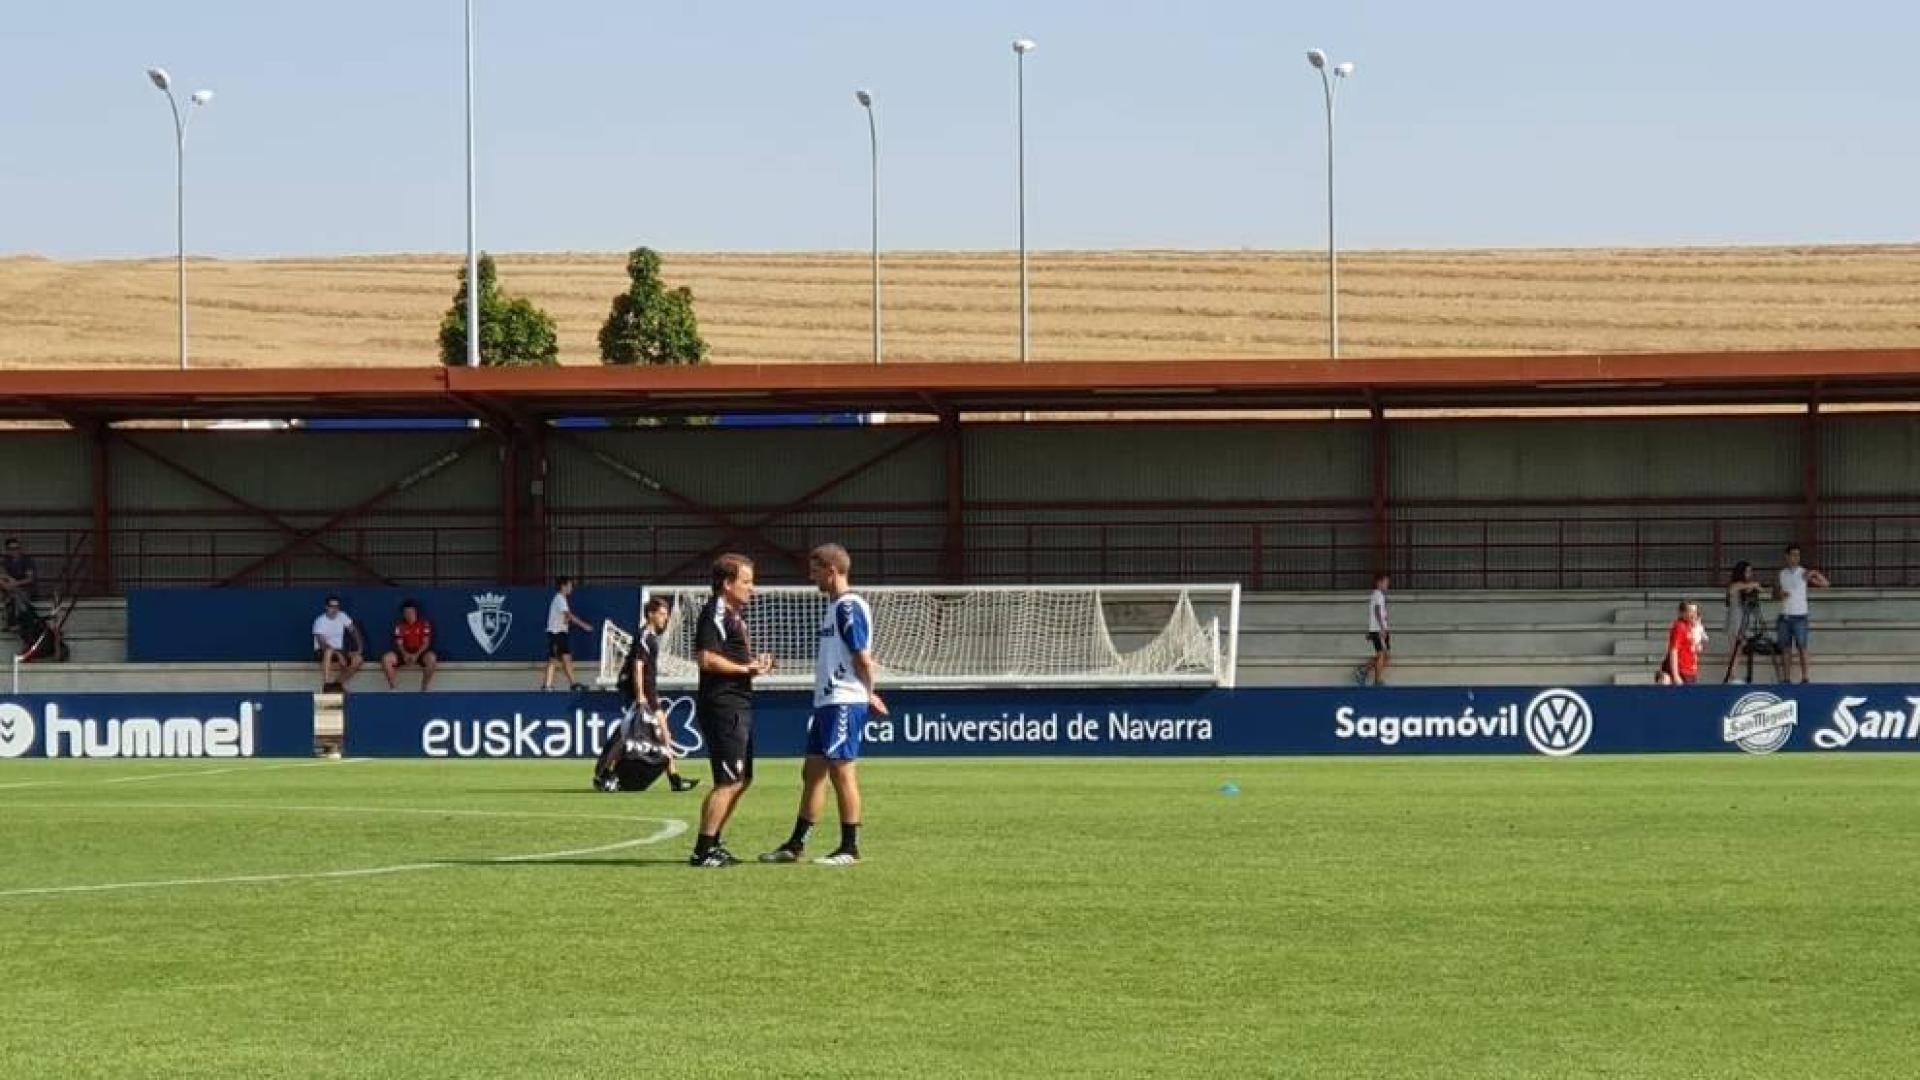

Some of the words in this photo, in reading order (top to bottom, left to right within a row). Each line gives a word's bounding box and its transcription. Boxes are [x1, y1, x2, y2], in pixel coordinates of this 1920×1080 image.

[45, 702, 253, 757] hummel
[904, 712, 1058, 742] Universidad
[1067, 712, 1099, 742] de
[1108, 712, 1213, 742] Navarra
[1335, 704, 1518, 745] Sagamóvil
